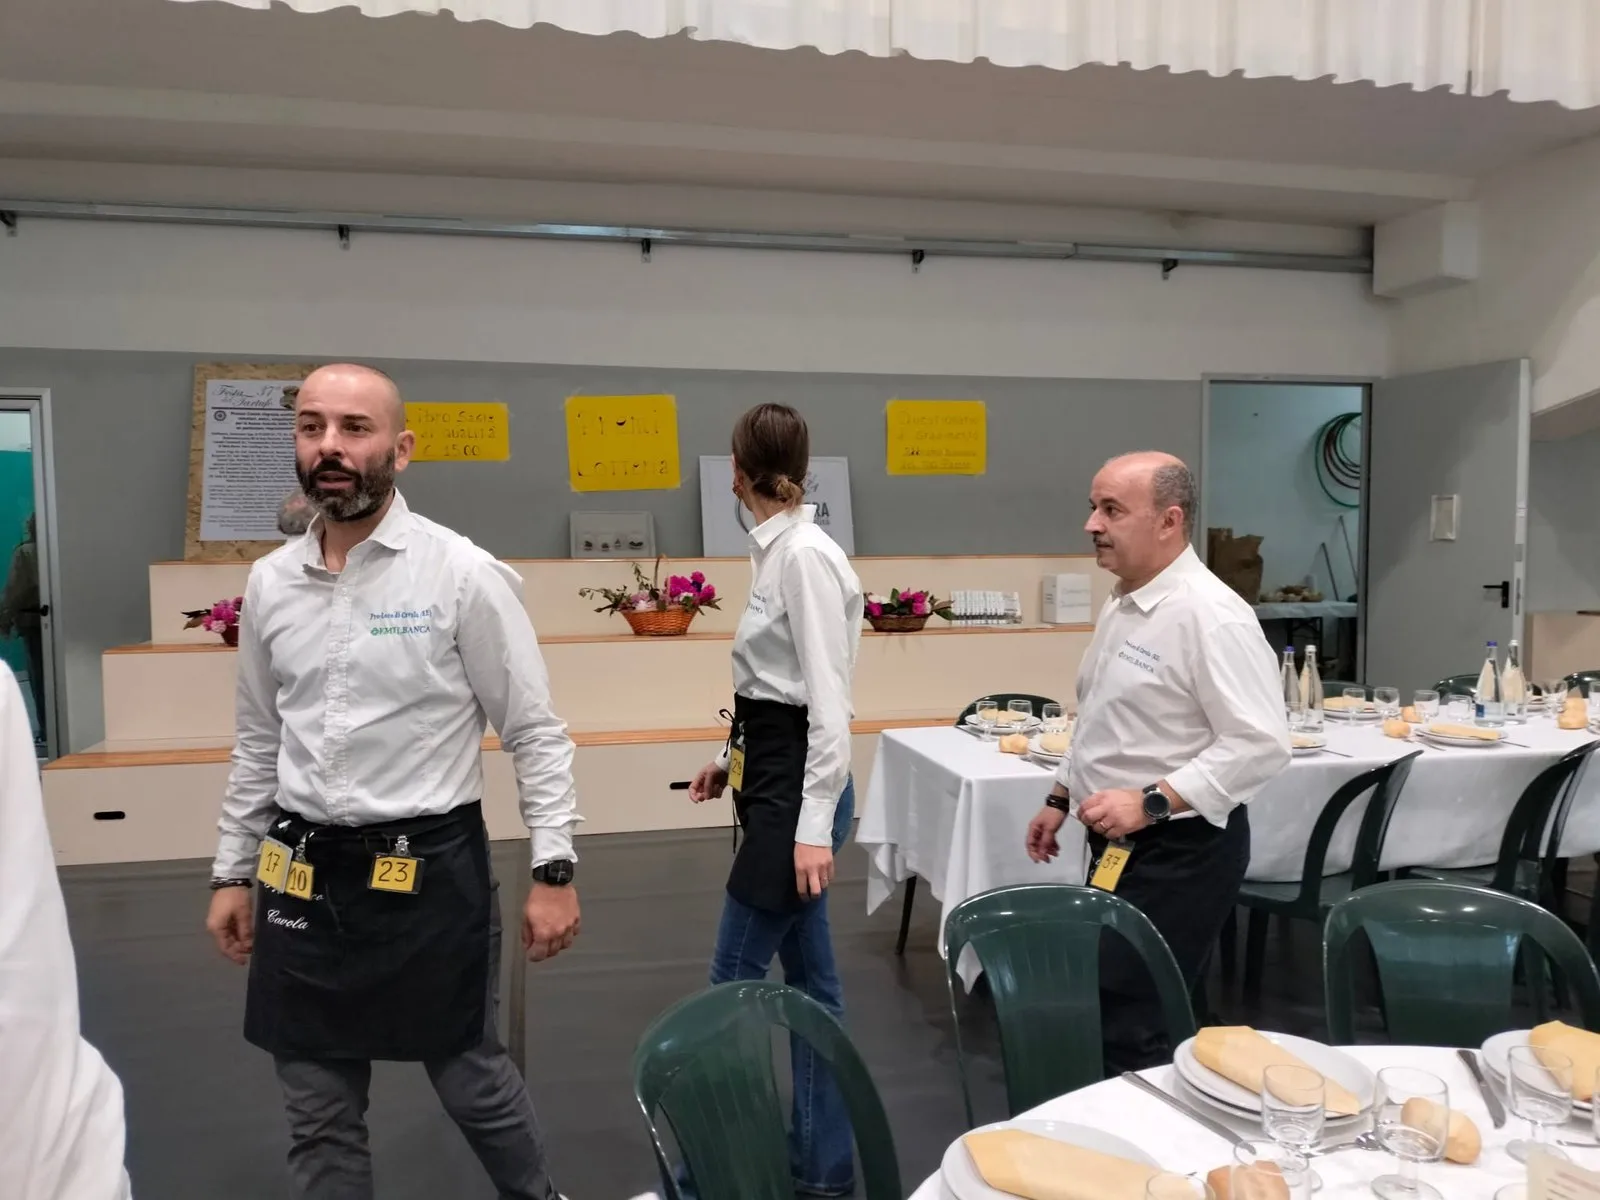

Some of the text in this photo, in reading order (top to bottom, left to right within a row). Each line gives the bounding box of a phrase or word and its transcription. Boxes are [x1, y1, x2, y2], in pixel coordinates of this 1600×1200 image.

[265, 851, 281, 874] 17
[378, 860, 408, 883] 23
[1102, 854, 1121, 871] 37
[289, 867, 307, 892] 10
[267, 909, 309, 930] Cavola
